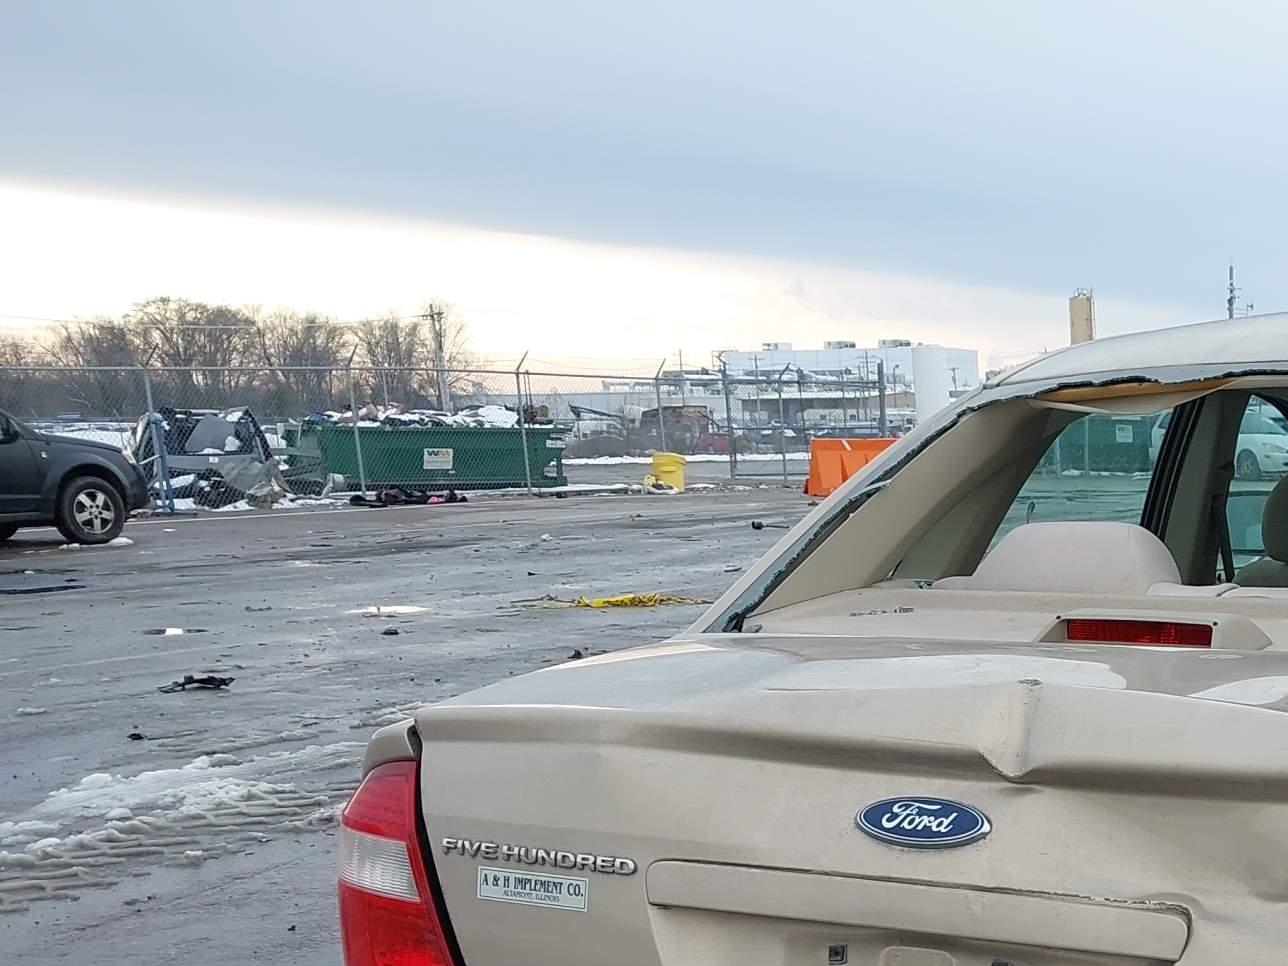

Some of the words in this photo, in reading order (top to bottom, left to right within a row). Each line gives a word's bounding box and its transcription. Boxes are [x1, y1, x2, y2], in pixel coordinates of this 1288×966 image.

[882, 801, 958, 832] Ford
[442, 837, 499, 860] FIVE
[502, 845, 638, 876] HUNDRED
[482, 873, 488, 886] A
[492, 874, 500, 887] &
[503, 875, 510, 888] H
[514, 877, 563, 895] IMPLEMENT
[567, 883, 583, 897] CO.
[535, 894, 560, 903] ILLINOIS
